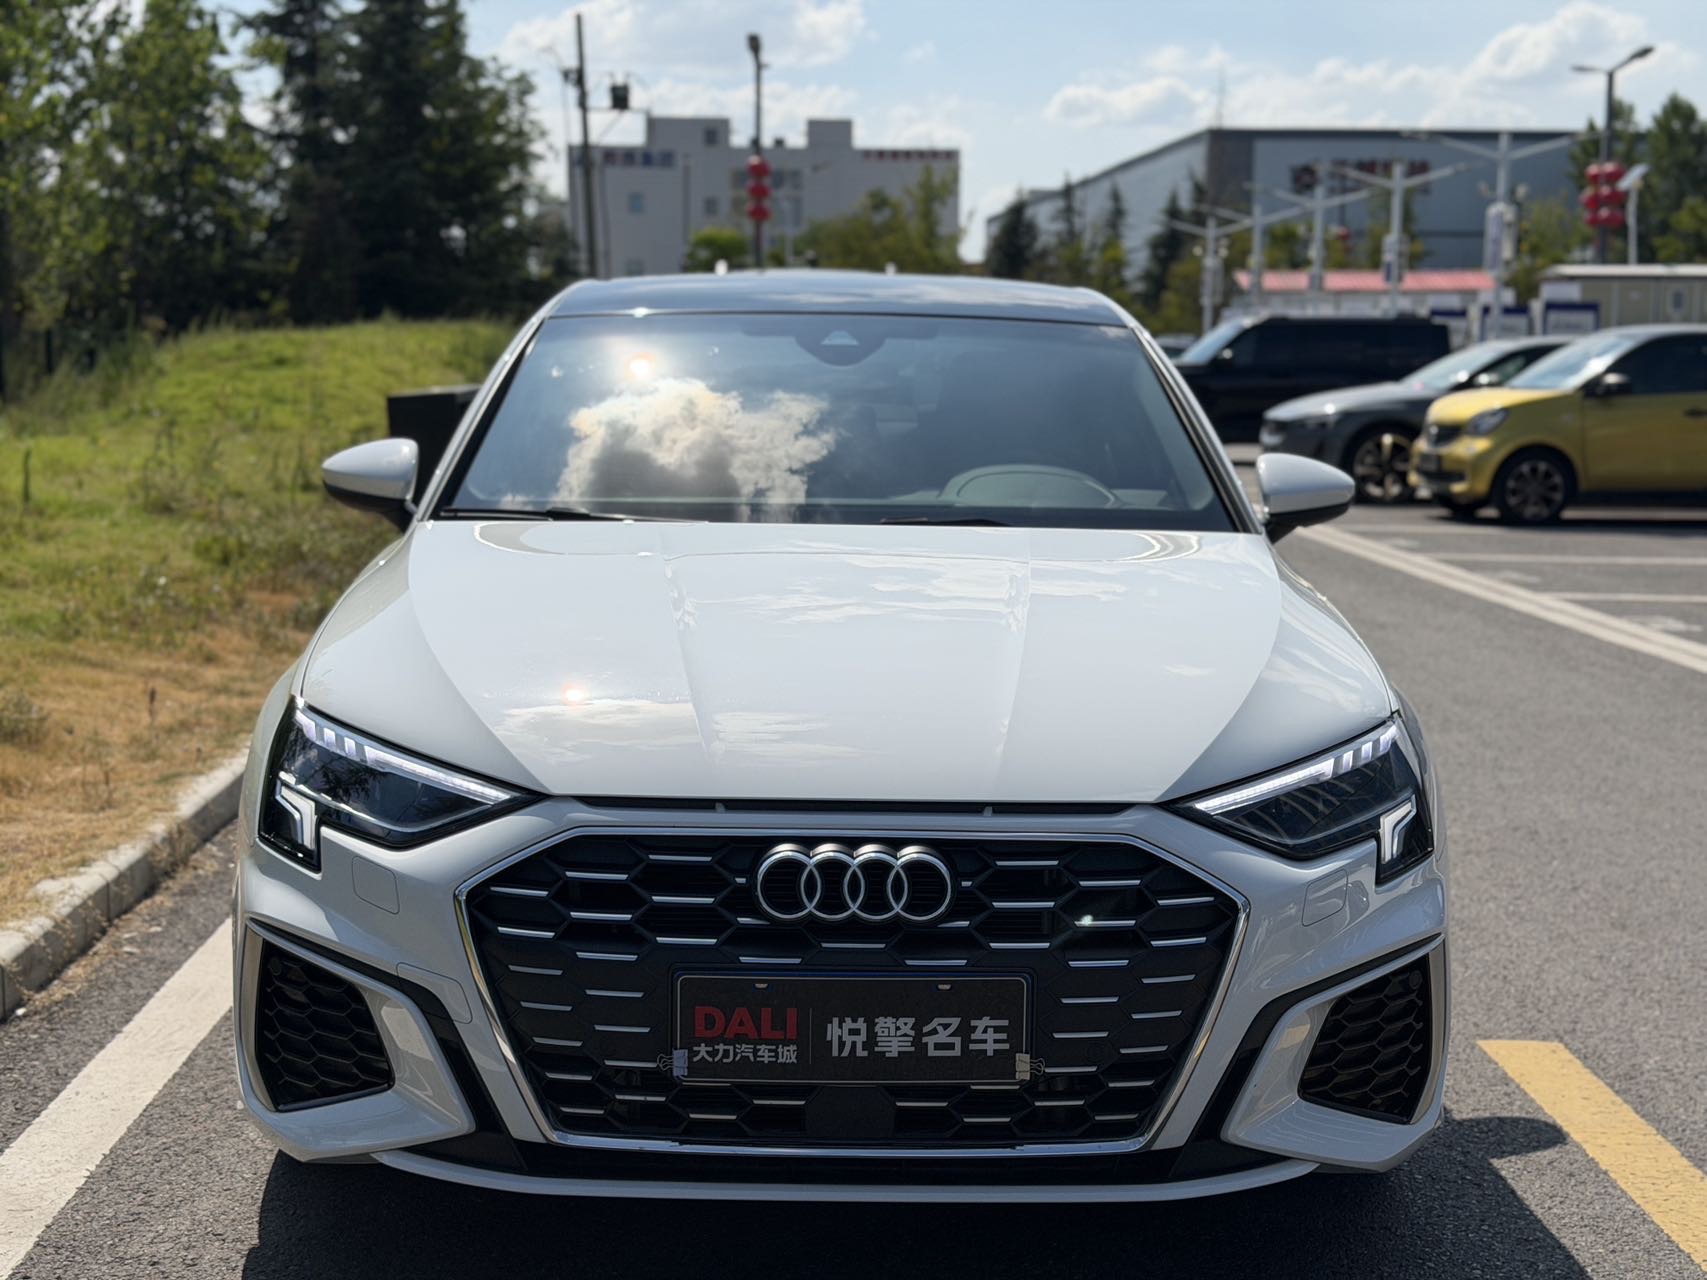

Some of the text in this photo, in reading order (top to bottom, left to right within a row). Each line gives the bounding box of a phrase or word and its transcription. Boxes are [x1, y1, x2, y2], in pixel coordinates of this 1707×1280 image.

[693, 1006, 798, 1040] DALI
[826, 1016, 1010, 1058] 悦擎名车
[693, 1043, 798, 1064] 大力汽车城
